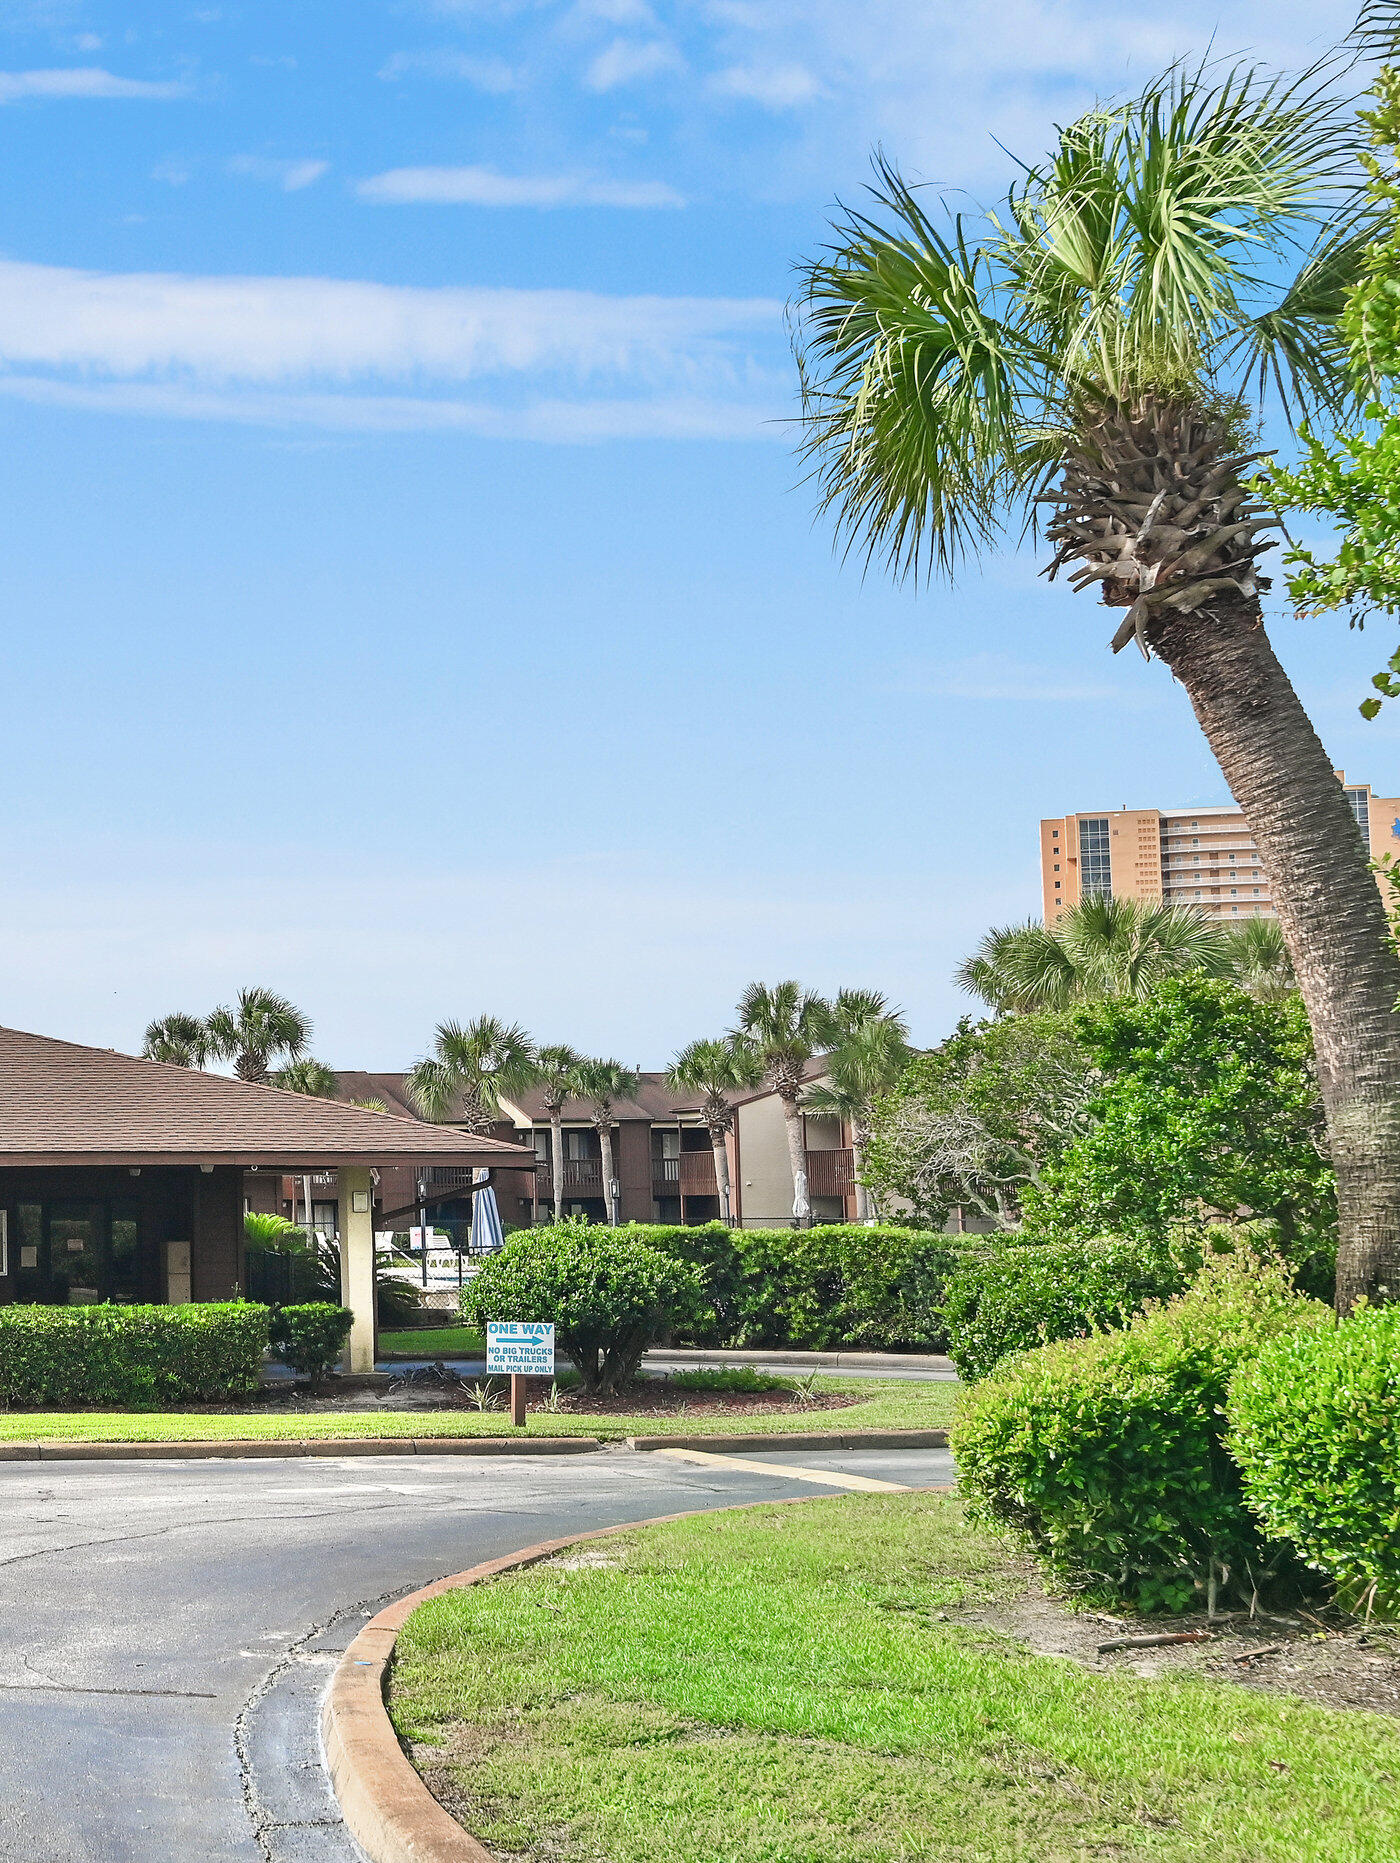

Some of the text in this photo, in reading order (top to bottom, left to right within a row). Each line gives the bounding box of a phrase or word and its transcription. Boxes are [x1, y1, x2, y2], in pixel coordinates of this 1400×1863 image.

[488, 1323, 553, 1335] ONE WAY
[488, 1347, 553, 1356] NO BIG TRUCKS
[493, 1355, 548, 1363] OR TRAILERS
[488, 1365, 505, 1373] MAIL
[506, 1365, 522, 1373] PICK
